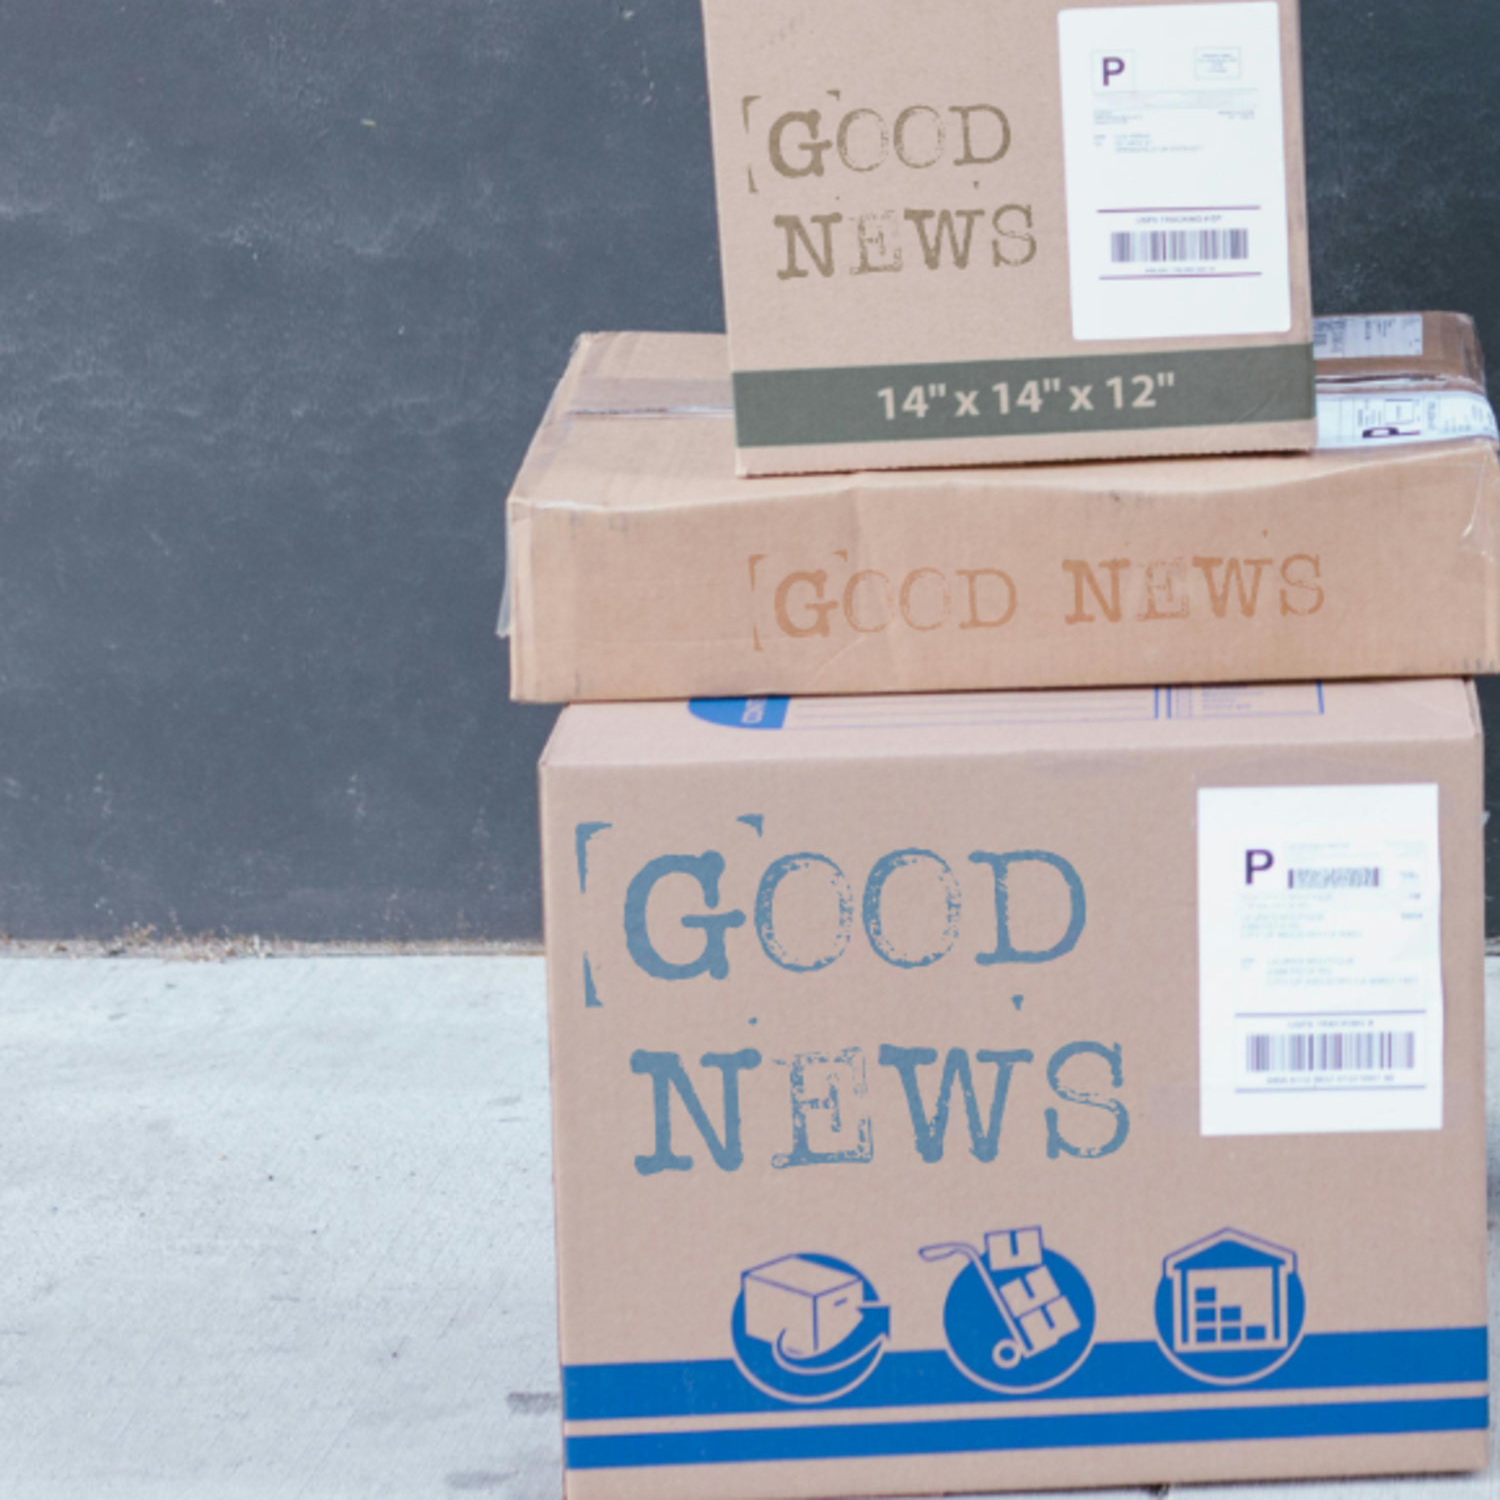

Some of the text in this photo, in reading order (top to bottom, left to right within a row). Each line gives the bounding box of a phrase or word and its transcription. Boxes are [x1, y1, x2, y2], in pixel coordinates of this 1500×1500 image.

[1102, 57, 1125, 86] P
[768, 103, 1011, 179] GOOD
[773, 203, 1037, 281] NEWS
[877, 372, 1174, 420] 14" x 14" x 12"
[774, 553, 1325, 638] GOOD NEWS
[1245, 848, 1275, 886] P
[623, 847, 1087, 982] GOOD
[629, 1040, 1130, 1177] NEWS
